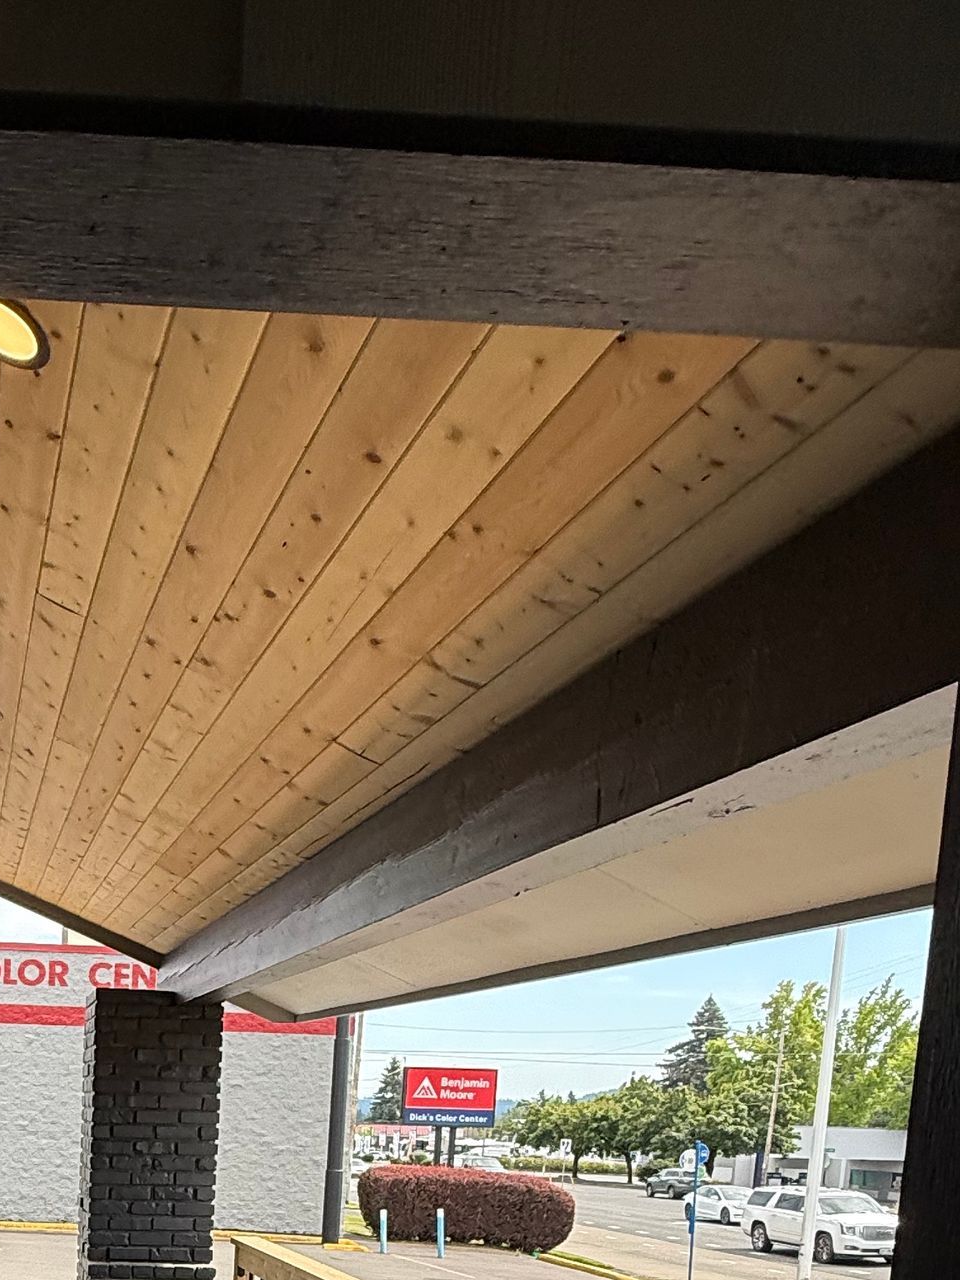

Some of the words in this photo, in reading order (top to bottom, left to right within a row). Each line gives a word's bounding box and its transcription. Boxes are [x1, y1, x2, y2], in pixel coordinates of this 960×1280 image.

[88, 962, 157, 989] CEN
[441, 1076, 490, 1090] Benjamin
[439, 1089, 474, 1100] Moore
[409, 1113, 434, 1121] Dick's
[435, 1114, 457, 1122] Color
[458, 1115, 488, 1123] Center
